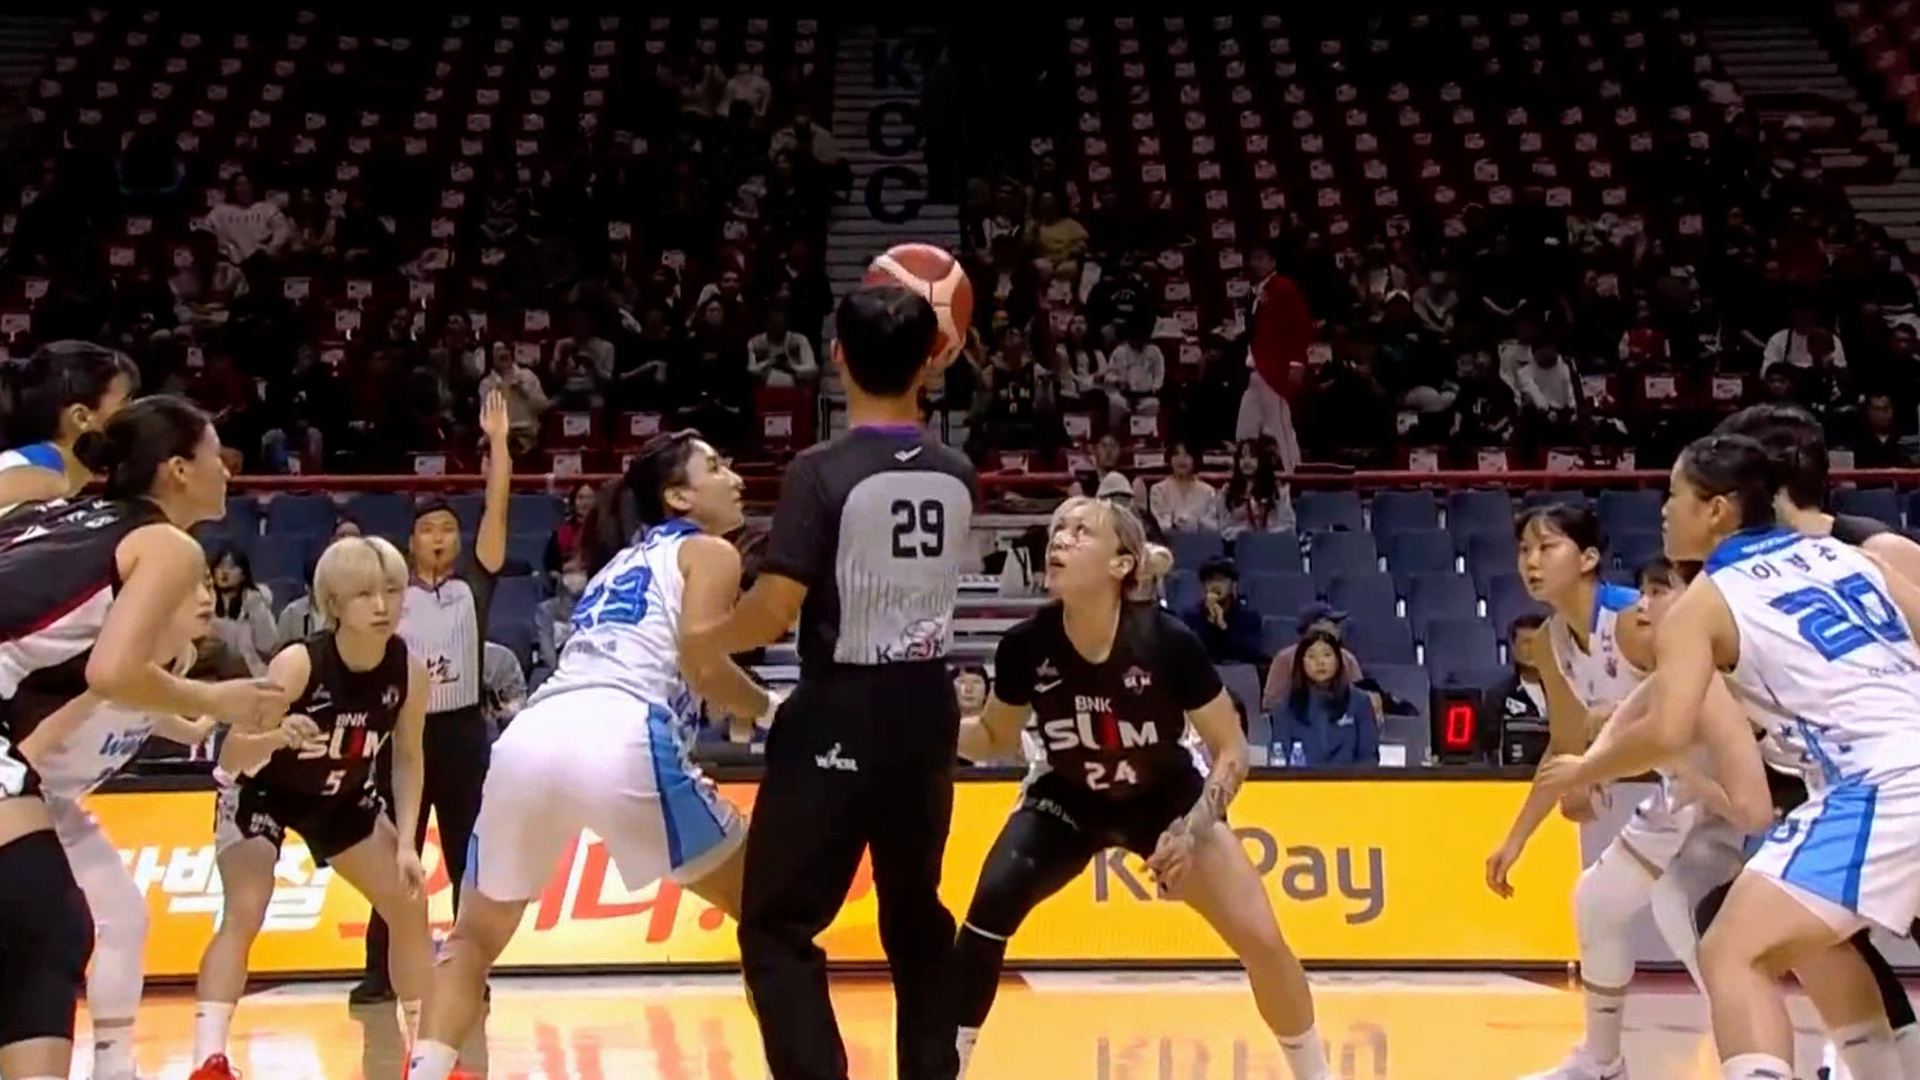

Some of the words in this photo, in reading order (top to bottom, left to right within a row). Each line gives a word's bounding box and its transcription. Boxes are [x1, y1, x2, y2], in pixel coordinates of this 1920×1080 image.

[891, 499, 944, 558] 29
[570, 565, 653, 630] 23
[1767, 572, 1909, 662] 20
[335, 711, 368, 727] BNK
[1074, 695, 1113, 713] BNK
[1044, 712, 1159, 750] SUM
[1446, 706, 1473, 744] 0
[320, 769, 348, 796] 5
[1084, 760, 1138, 791] 24
[1232, 827, 1385, 925] Pay
